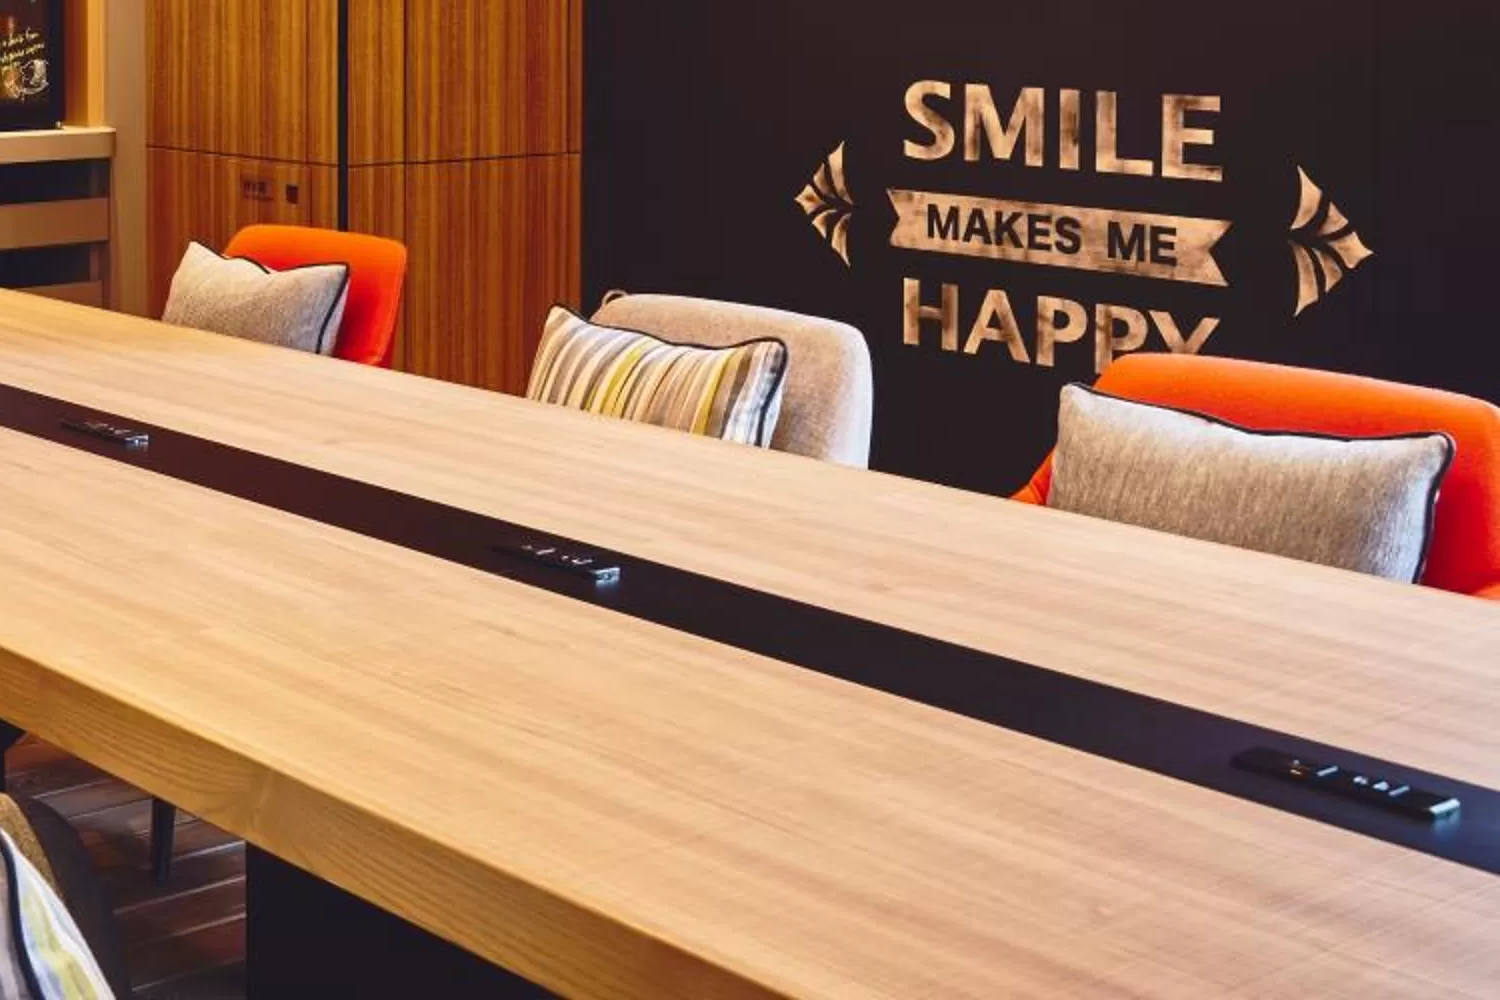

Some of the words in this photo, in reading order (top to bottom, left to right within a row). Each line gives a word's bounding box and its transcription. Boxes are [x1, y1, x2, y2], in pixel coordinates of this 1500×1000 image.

[902, 80, 1222, 183] SMILE
[926, 203, 1081, 255] MAKES
[1107, 221, 1177, 266] ME
